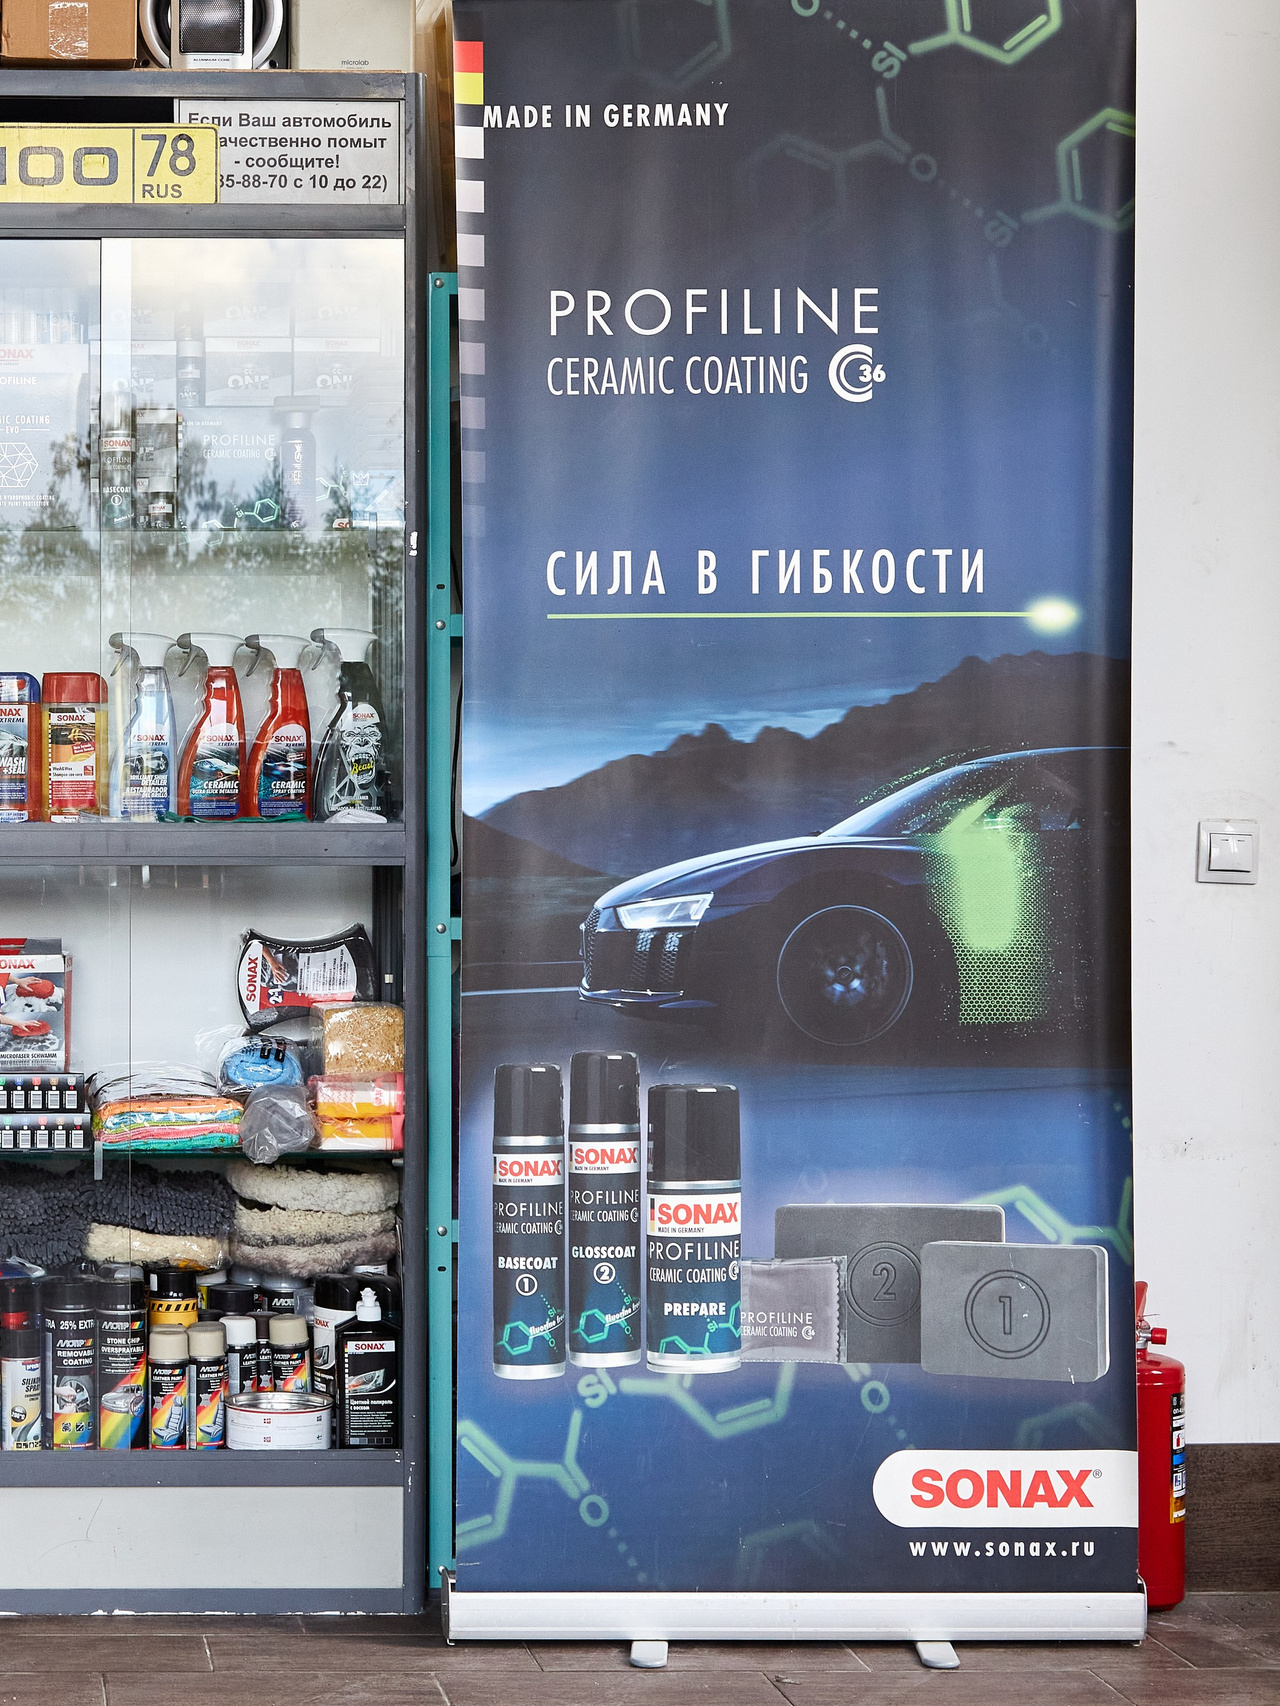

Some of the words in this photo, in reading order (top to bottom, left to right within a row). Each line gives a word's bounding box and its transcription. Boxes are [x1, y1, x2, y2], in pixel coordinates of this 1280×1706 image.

[238, 113, 276, 127] Ваш
[282, 114, 392, 128] автомобиль
[483, 105, 552, 129] MADE
[565, 105, 592, 128] IN
[603, 103, 729, 127] GERMANY
[219, 136, 322, 149] ачественно
[327, 137, 387, 149] помыт
[140, 133, 197, 177] 78
[245, 154, 340, 170] сообщите!
[141, 183, 183, 199] RUS
[218, 175, 288, 189] 35-88-70
[293, 179, 304, 189] с
[309, 175, 329, 189] 10
[333, 177, 357, 191] до
[361, 175, 388, 192] 22)
[550, 288, 880, 336] PROFILINE
[547, 356, 674, 396] CERAMIC
[686, 355, 808, 394] COATING
[15, 414, 50, 424] COATING
[5, 426, 20, 434] EVO
[103, 439, 132, 448] SONAX
[203, 434, 275, 446] PROFILINE
[203, 449, 232, 459] CERAMIC
[233, 449, 261, 459] COATING
[546, 550, 666, 597] СИЛА
[698, 551, 718, 595] В
[750, 548, 986, 595] ГИБКОСТИ
[56, 714, 86, 722] SONAX
[351, 760, 374, 775] Beast
[203, 781, 239, 789] CERAMIC
[271, 781, 306, 789] CERAMIC
[246, 956, 259, 1002] SONAX
[574, 1147, 638, 1165] SONAX
[498, 1160, 562, 1177] SONAX
[570, 1189, 639, 1205] PROFILINE
[494, 1201, 563, 1218] PROFILINE
[571, 1211, 595, 1222] ERAMIC
[597, 1210, 629, 1222] COATING
[657, 1202, 738, 1225] SONAX
[495, 1222, 519, 1235] ERAMIC
[520, 1222, 553, 1235] COATING
[572, 1245, 636, 1259] GLOSSCOAT
[649, 1240, 740, 1261] PROFILINE
[498, 1256, 558, 1270] BASECOAT
[649, 1268, 685, 1283] CERAMIC
[686, 1267, 727, 1283] COATING
[872, 1262, 897, 1302] 2
[664, 1302, 726, 1316] PREPARE
[998, 1296, 1013, 1336] 1
[60, 1320, 77, 1330] 25%
[78, 1319, 95, 1330] EXTR
[740, 1311, 813, 1325] PROFILINE
[740, 1325, 767, 1337] CERAMIC
[768, 1325, 798, 1337] COATING
[909, 1540, 1096, 1557] www.sonax.ru
